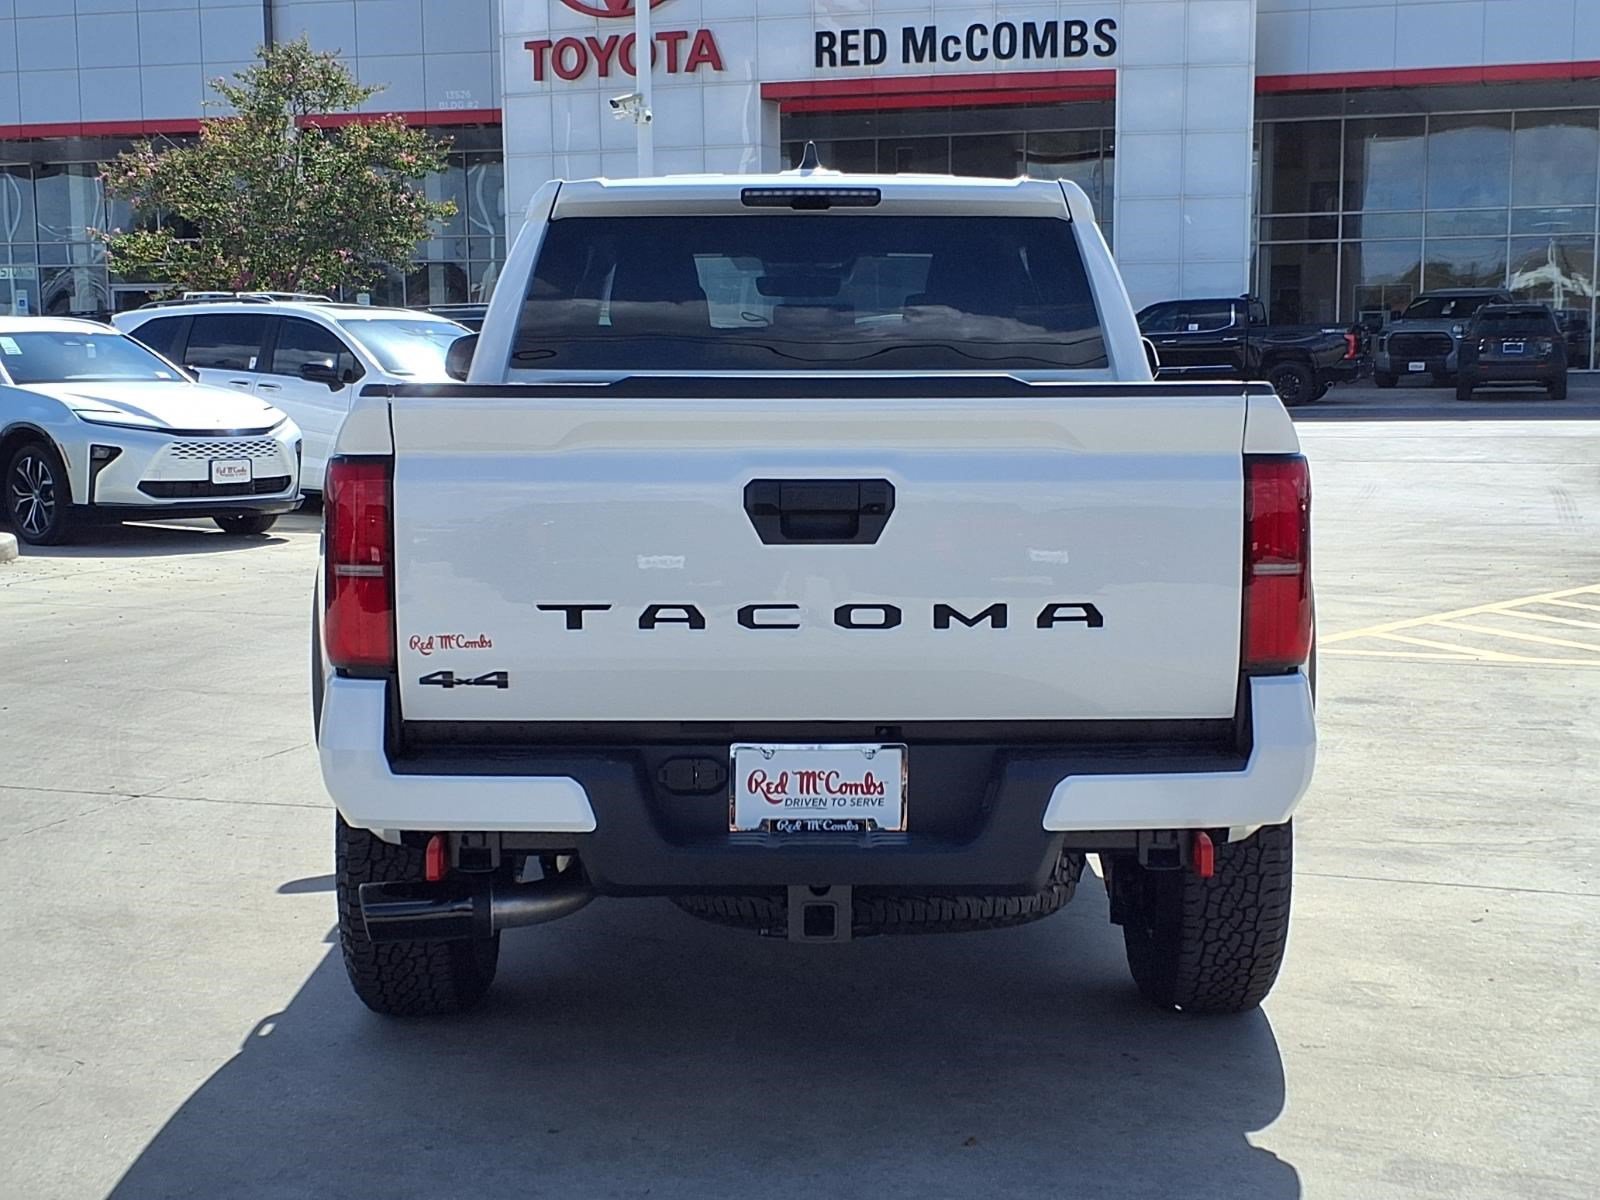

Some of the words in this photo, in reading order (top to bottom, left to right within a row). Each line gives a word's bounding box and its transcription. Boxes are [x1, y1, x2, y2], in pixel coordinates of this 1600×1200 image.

[524, 29, 723, 81] TOYOTA
[815, 28, 887, 68] RED
[902, 18, 1117, 64] McCOMBS
[536, 603, 1104, 630] TACOMA
[409, 635, 434, 656] Red
[436, 634, 492, 649] McCombs
[419, 671, 508, 688] 4x4
[747, 769, 788, 804] Red
[792, 770, 885, 796] McCombs
[784, 797, 828, 808] DRIVEN
[831, 797, 847, 807] TO
[849, 797, 885, 807] SERVE
[776, 819, 802, 832] Red
[805, 819, 859, 831] McCombs
